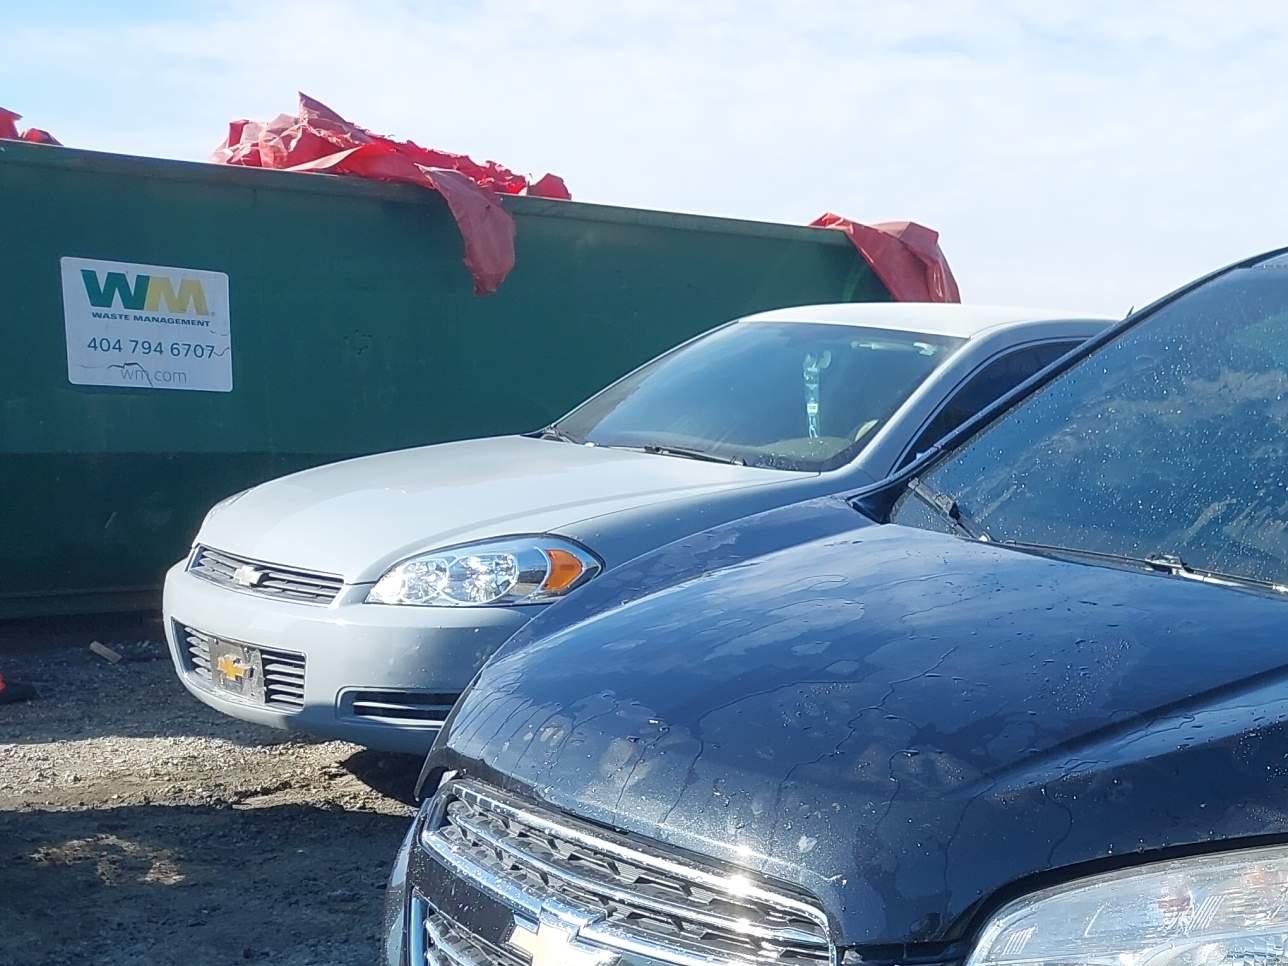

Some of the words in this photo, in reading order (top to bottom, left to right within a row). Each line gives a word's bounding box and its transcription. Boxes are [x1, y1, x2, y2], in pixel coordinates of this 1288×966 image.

[80, 269, 208, 316] WM
[91, 311, 130, 321] WASTE
[133, 315, 211, 327] MANAGEMENT
[87, 337, 123, 352] 404
[129, 339, 164, 355] 794
[170, 342, 215, 359] 6707
